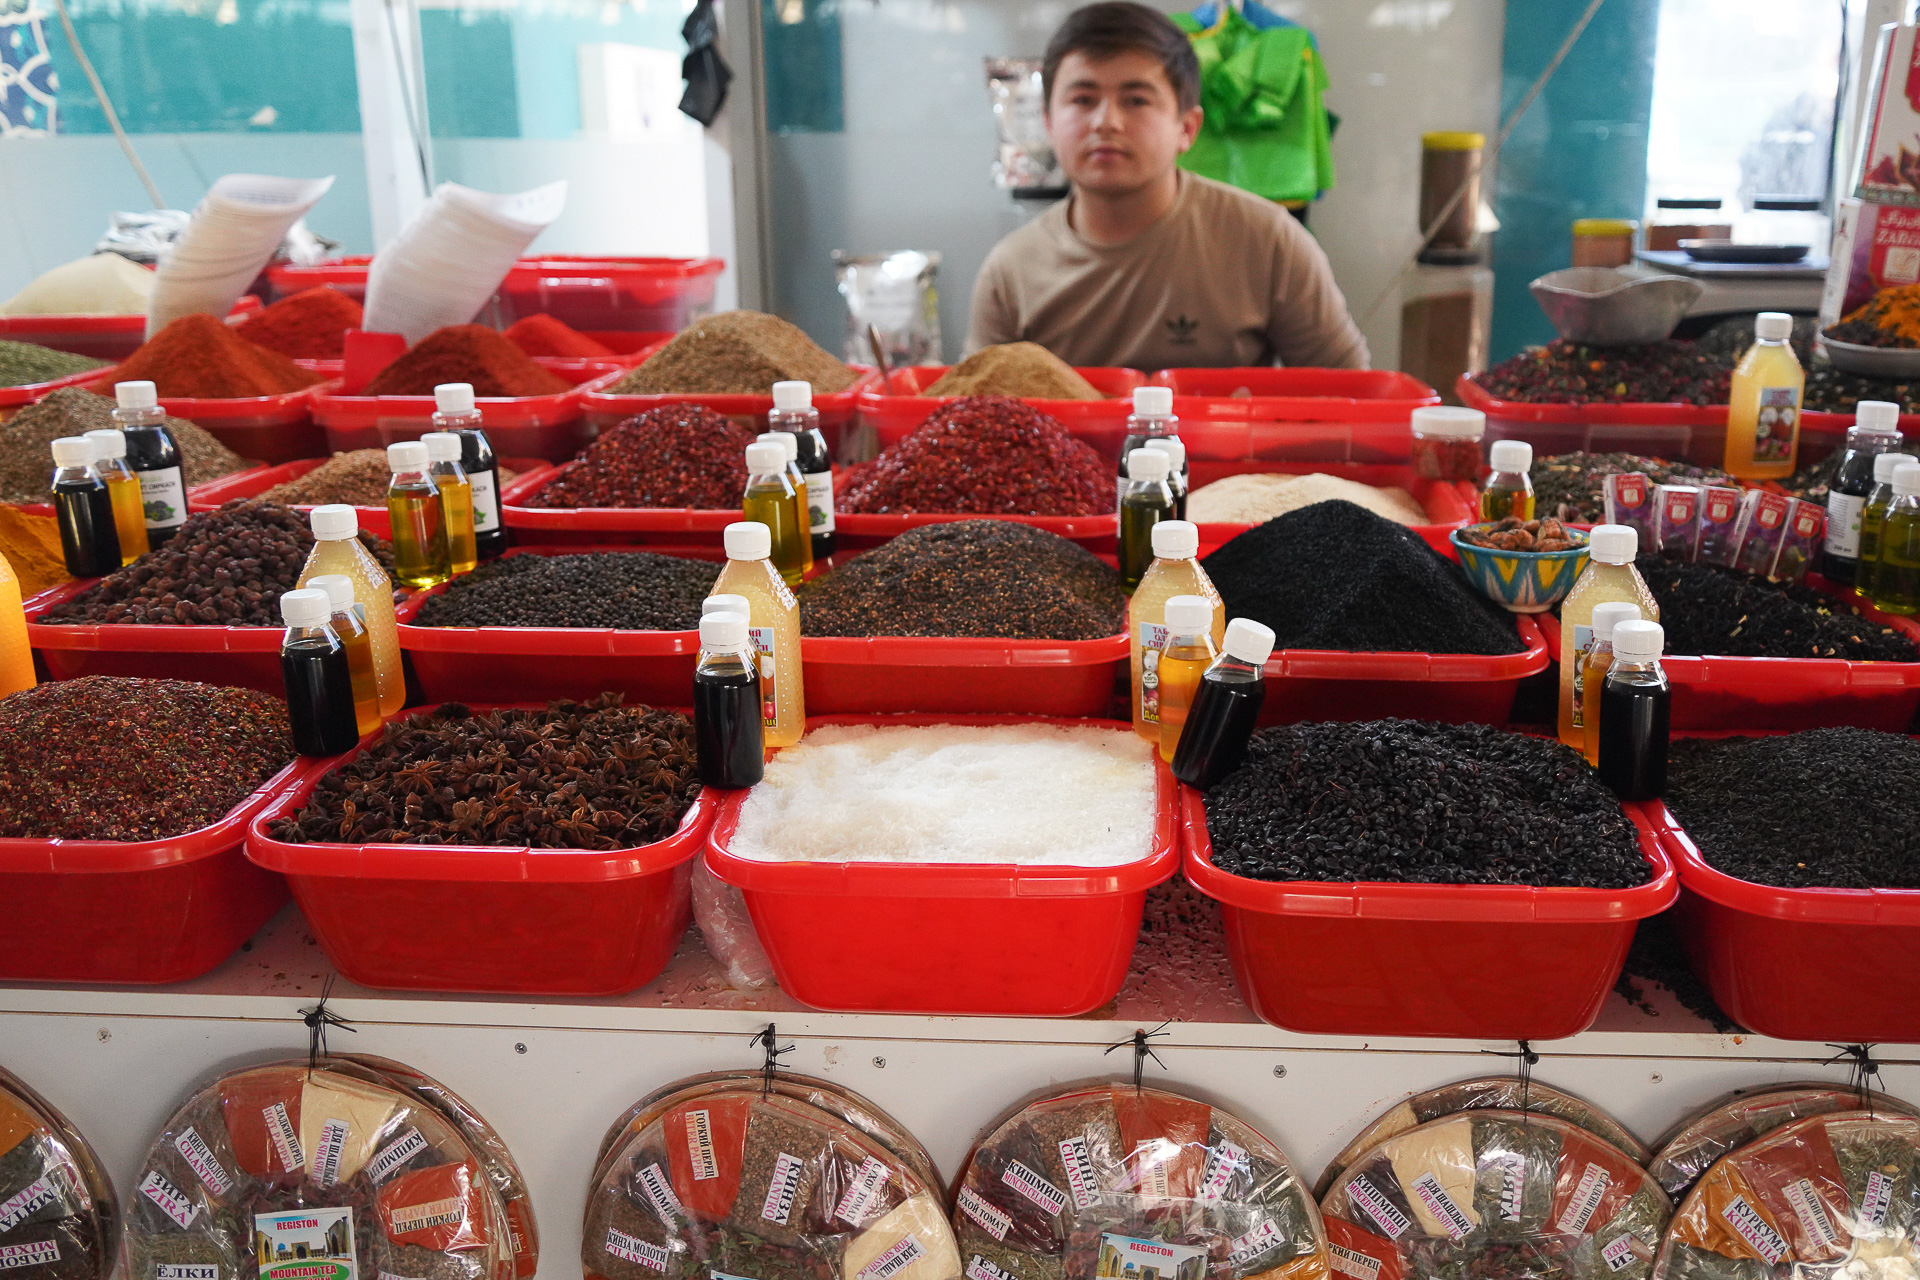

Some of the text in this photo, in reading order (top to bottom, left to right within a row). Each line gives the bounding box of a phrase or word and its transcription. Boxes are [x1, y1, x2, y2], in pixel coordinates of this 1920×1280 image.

[263, 1108, 293, 1171] HOT PAPPER
[286, 1136, 304, 1166] ПЕРЕЦ
[332, 1125, 344, 1142] ДЛЯ
[686, 1114, 705, 1179] BITER PAPER
[695, 1111, 716, 1178] ГОРКИЙ ПЕРЕЦ
[180, 1140, 223, 1195] CILANTRO
[186, 1131, 234, 1189] КИНЗА МОЛОТИ
[1061, 1143, 1089, 1207] CILANTRO
[1073, 1141, 1100, 1206] КИНЗА
[1206, 1149, 1237, 1200] ZIRA
[145, 1184, 187, 1226] ZIRA
[151, 1173, 194, 1215] ЗИРА
[764, 1157, 789, 1219] CILANTRO
[775, 1161, 802, 1222] КИНЗА
[849, 1189, 869, 1221] ТОМАТ
[1003, 1171, 1061, 1215] MINCED CELANTRO
[1007, 1161, 1066, 1205] КИШМИШ
[1355, 1174, 1409, 1230] КИШМИШ
[1500, 1159, 1518, 1220] МЯТА
[1560, 1165, 1599, 1226] HOT PAPPER
[1864, 1173, 1880, 1210] GREEN
[276, 1218, 319, 1231] REGISTON
[395, 1218, 426, 1235] ПЕРЕЦ
[400, 1205, 428, 1225] PAPER
[979, 1208, 1007, 1231] ТОМАТ
[1347, 1183, 1399, 1236] MINCED CELANTRO
[1416, 1185, 1463, 1239] FOR SHASHLIK
[1421, 1178, 1472, 1235] ДЛЯ ШАШЛЫКА
[1573, 1205, 1594, 1232] ПЕРЕЦ
[1734, 1200, 1788, 1256] КУРКУМА
[1787, 1184, 1823, 1248] HOT PAPPER
[1799, 1179, 1835, 1242] СЛАДКИЙ ПЕРЕЦ
[606, 1244, 663, 1271] CILANTRO
[607, 1231, 631, 1250] КИНЗА
[633, 1241, 667, 1263] МОЛОТИ
[896, 1239, 911, 1253] FOR
[904, 1243, 919, 1259] ДЛЯ
[1129, 1242, 1174, 1257] REGISTON
[1351, 1250, 1380, 1272] ПЕРЕЦ
[156, 1264, 216, 1280] ЁЛКИ
[269, 1265, 337, 1280] MOUNTAIN TEA
